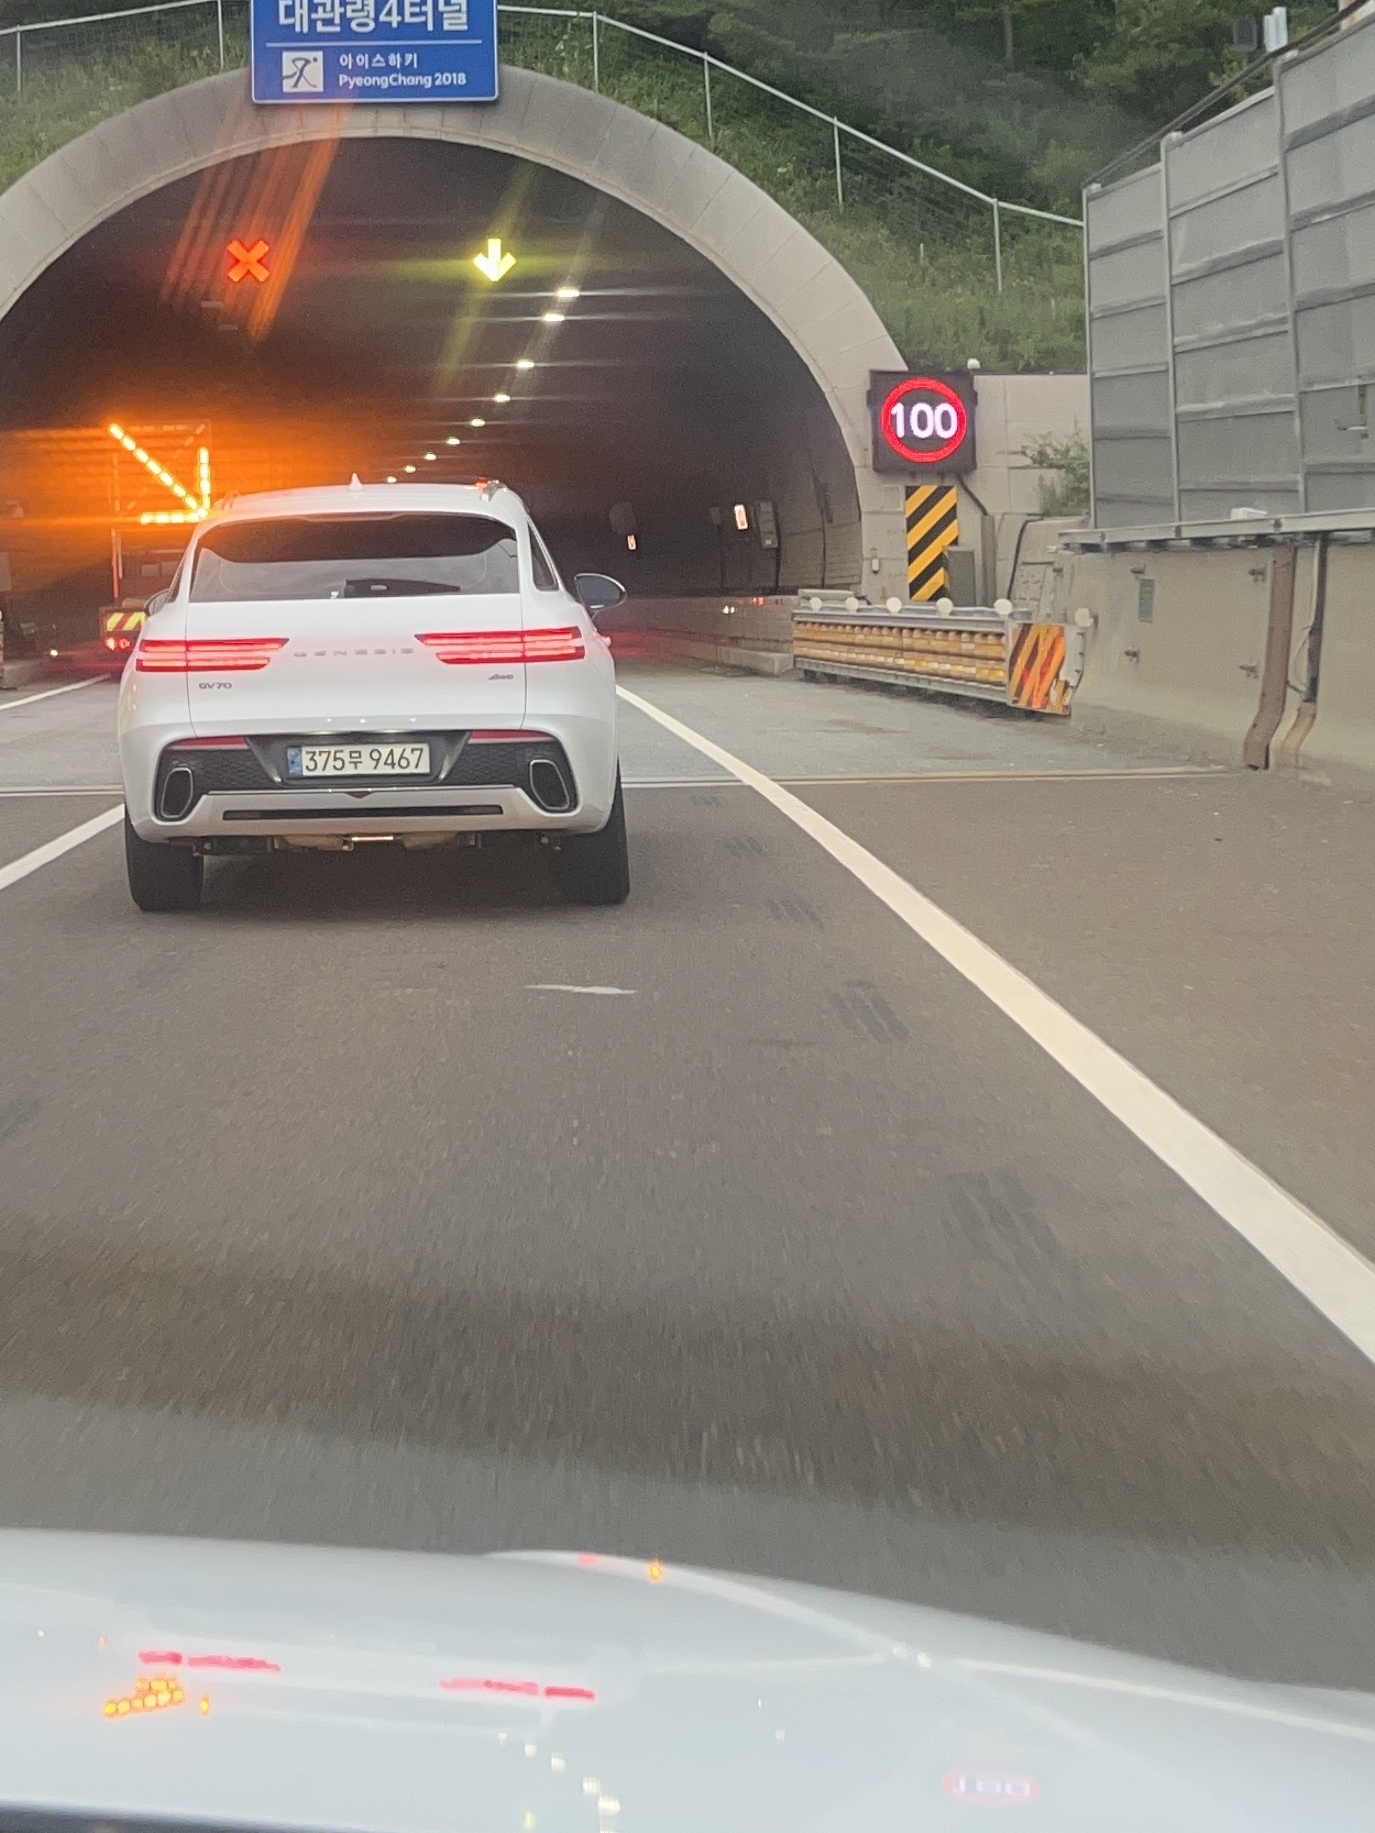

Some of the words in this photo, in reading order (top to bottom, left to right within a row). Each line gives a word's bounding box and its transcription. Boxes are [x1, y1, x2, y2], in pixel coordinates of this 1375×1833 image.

[339, 52, 418, 69] 아이스하키
[338, 73, 432, 89] PyeongChang
[434, 72, 467, 86] 2018
[891, 403, 958, 439] 100
[305, 750, 363, 772] 375무
[369, 748, 423, 770] 9467
